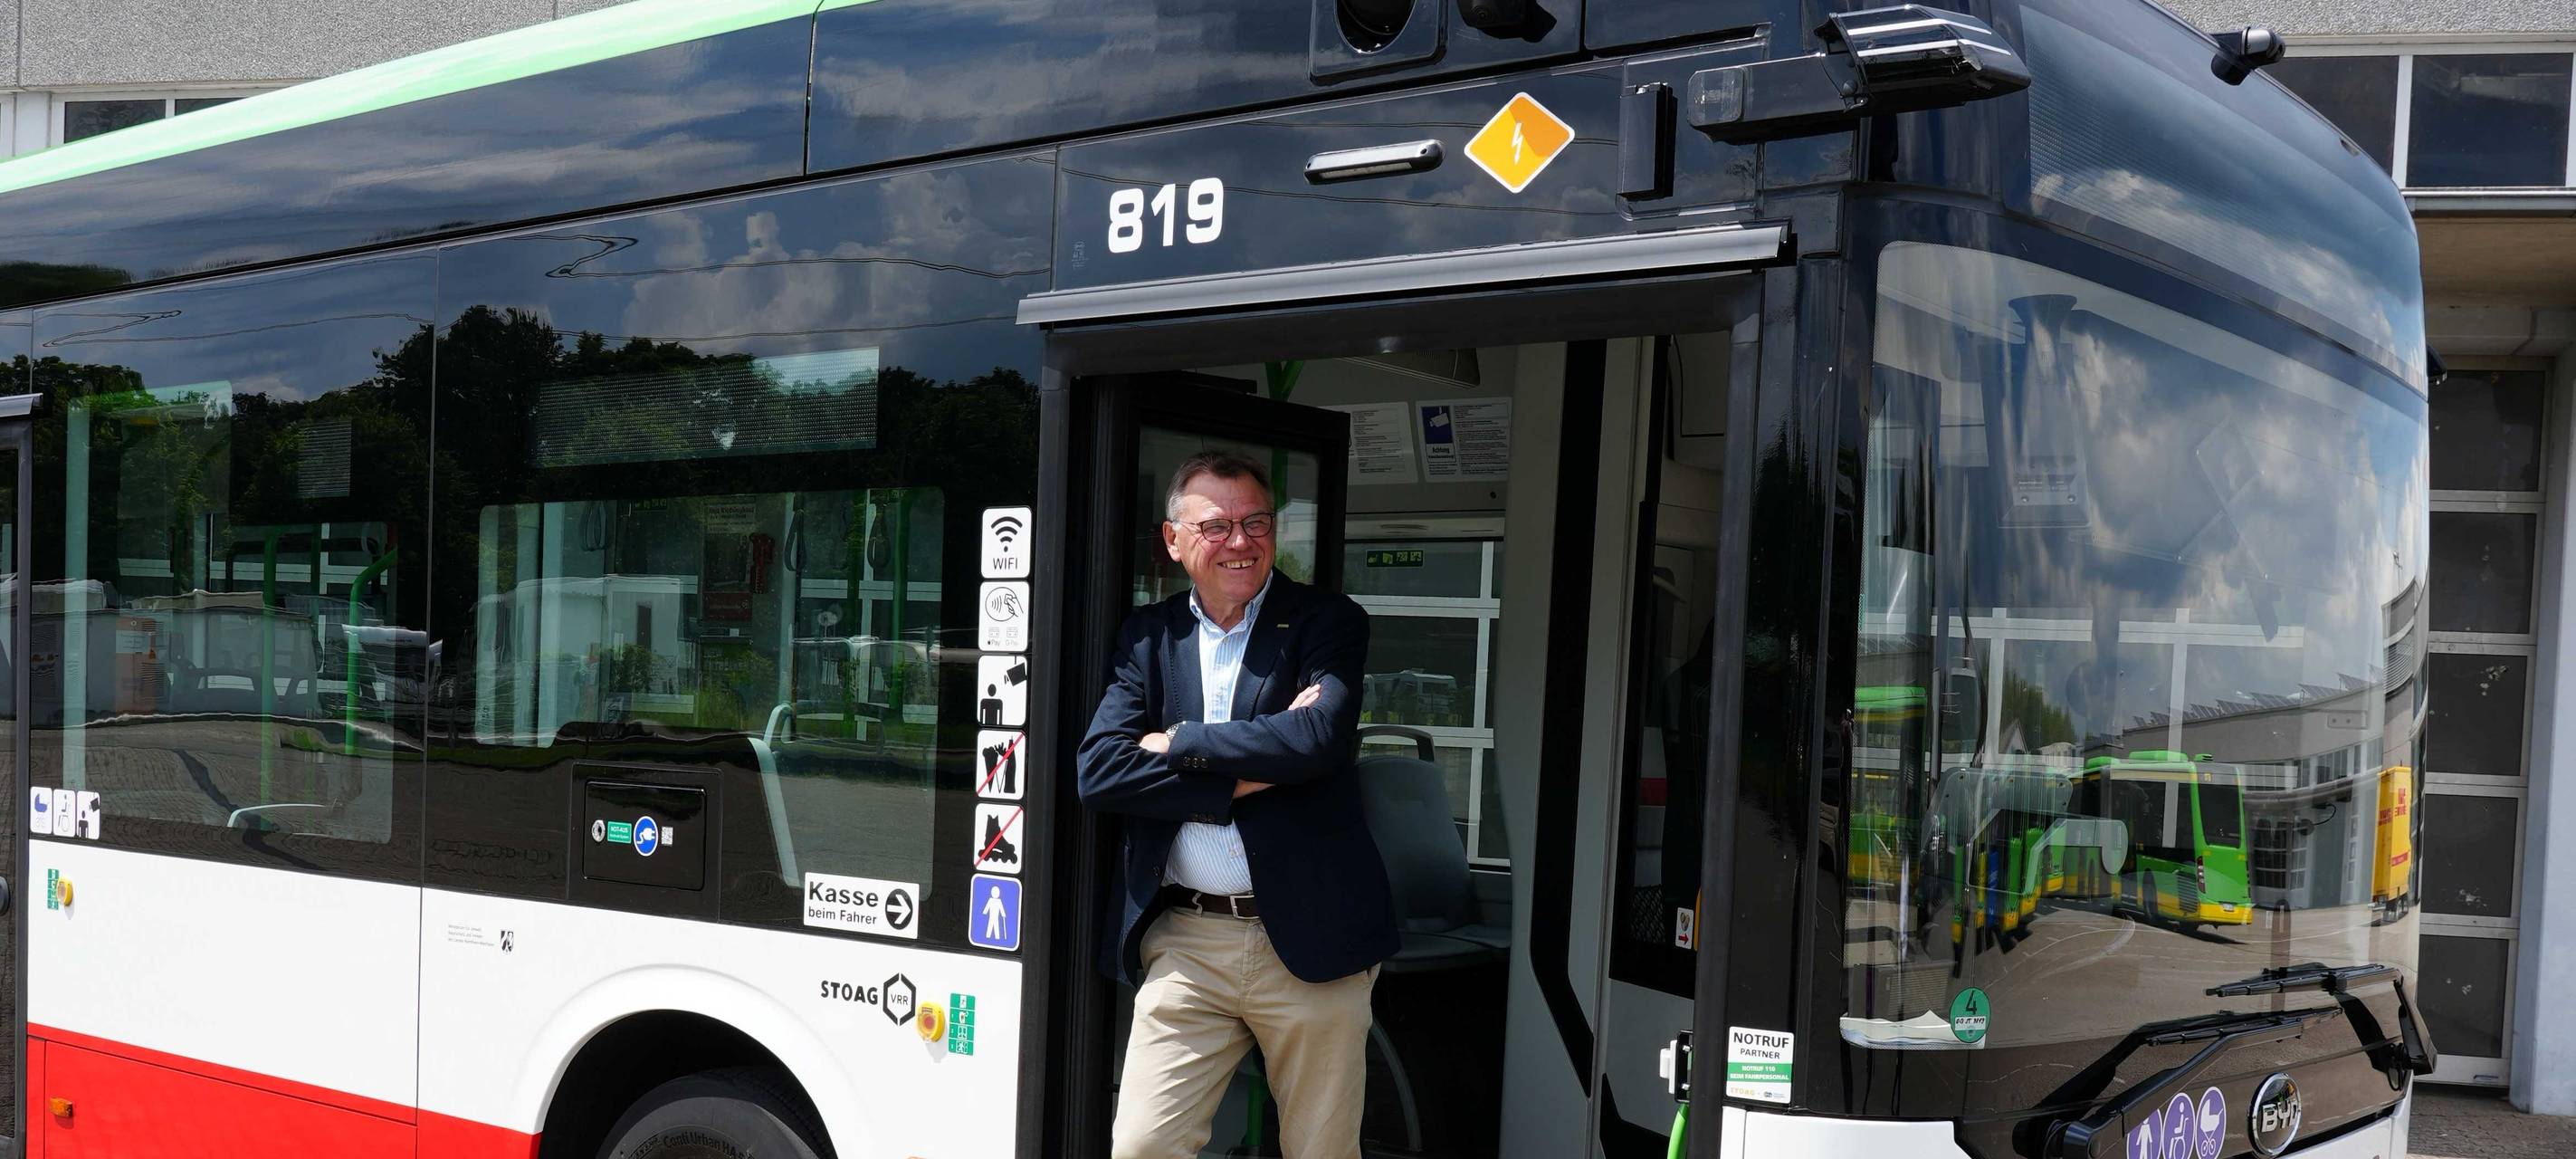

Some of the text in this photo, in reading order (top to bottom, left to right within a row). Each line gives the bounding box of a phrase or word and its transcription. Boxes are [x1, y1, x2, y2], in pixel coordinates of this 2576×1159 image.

[1108, 177, 1224, 253] 819
[993, 557, 1018, 570] WIFI
[808, 881, 879, 908] Kasse
[808, 906, 877, 924] beim Fahrer
[820, 980, 879, 1005] STOAG
[890, 993, 909, 1005] VRR
[1965, 990, 1978, 1015] 4
[1733, 1032, 1789, 1049] NOTRUF
[1740, 1048, 1780, 1059] PARTNER
[2261, 1099, 2298, 1133] BYD
[663, 1131, 690, 1148] Conti
[692, 1132, 720, 1150] Urban
